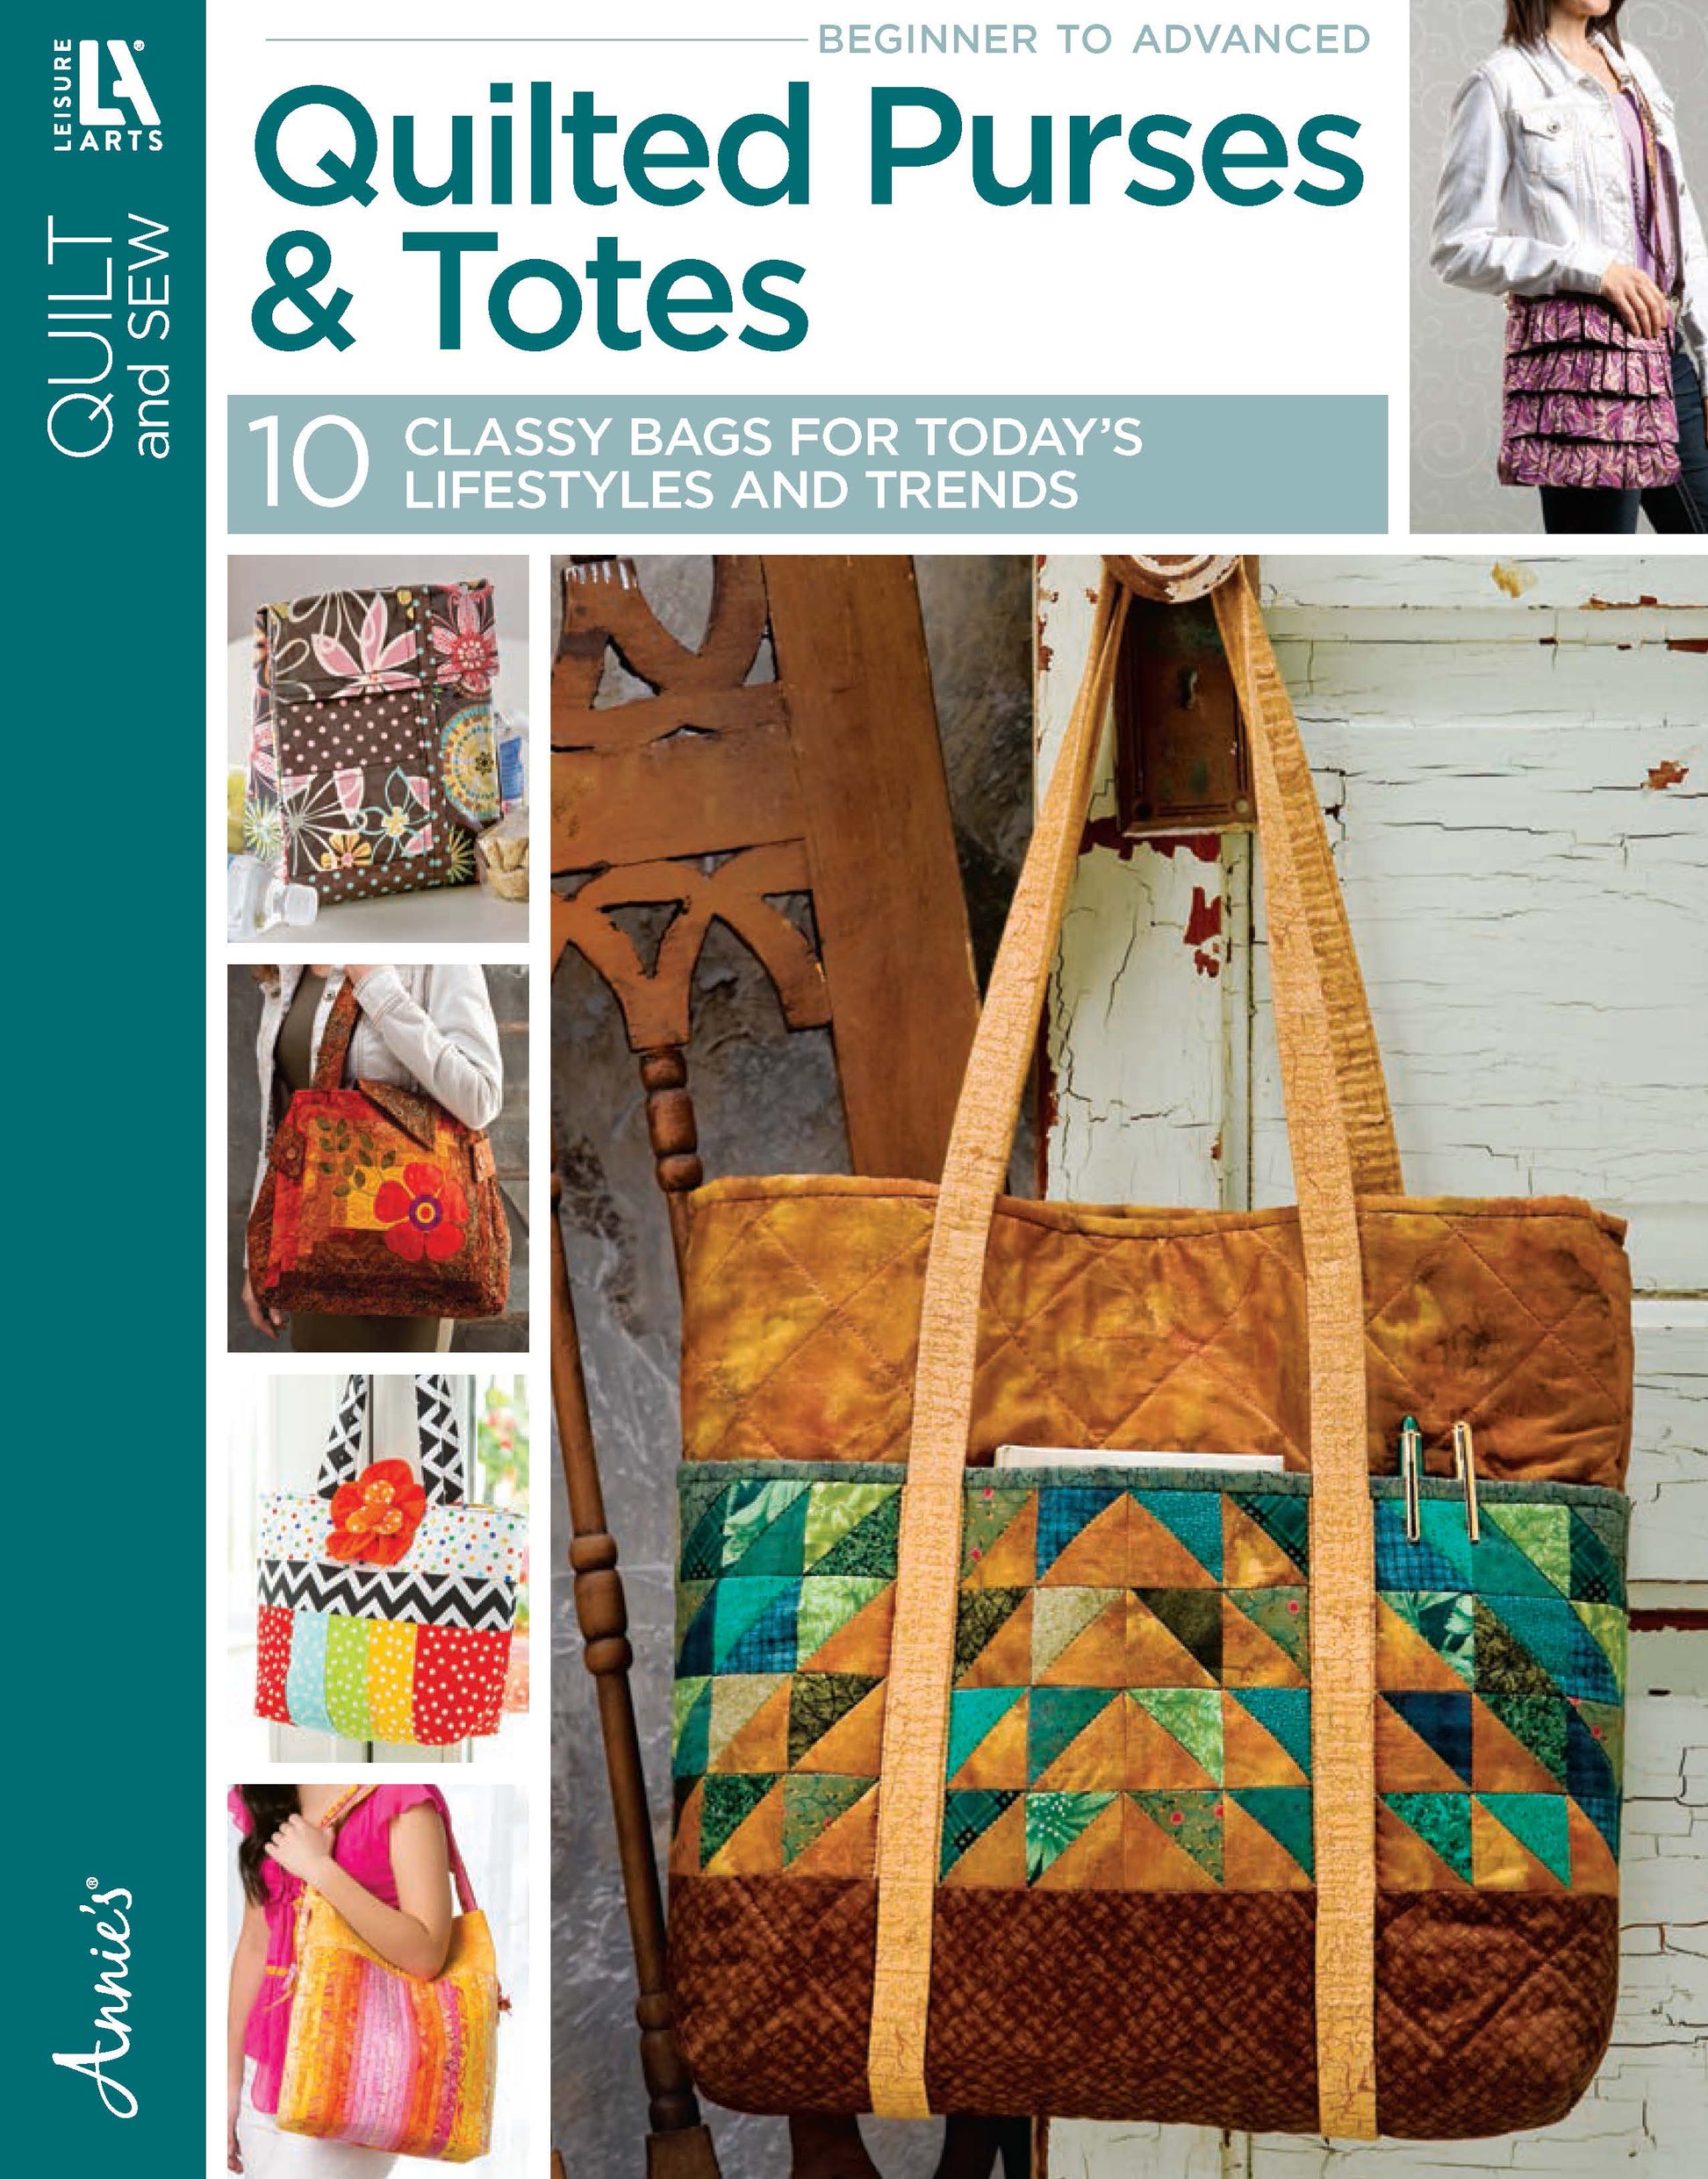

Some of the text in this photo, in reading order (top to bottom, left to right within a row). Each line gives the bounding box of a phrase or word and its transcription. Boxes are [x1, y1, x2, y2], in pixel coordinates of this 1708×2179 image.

[820, 24, 1370, 54] BEGINNER TO ADVANCED
[54, 39, 72, 151] LEISURE
[80, 130, 163, 151] ARTS
[254, 82, 1364, 208] Quilted Purses
[47, 215, 114, 458] QUILT
[127, 212, 169, 458] and SEW
[251, 229, 809, 352] & Totes
[248, 414, 370, 508] 10
[405, 417, 1143, 457] CLASSY BAGS FOR TODAY’S
[406, 470, 1079, 509] LIFESTYLES AND TRENDS
